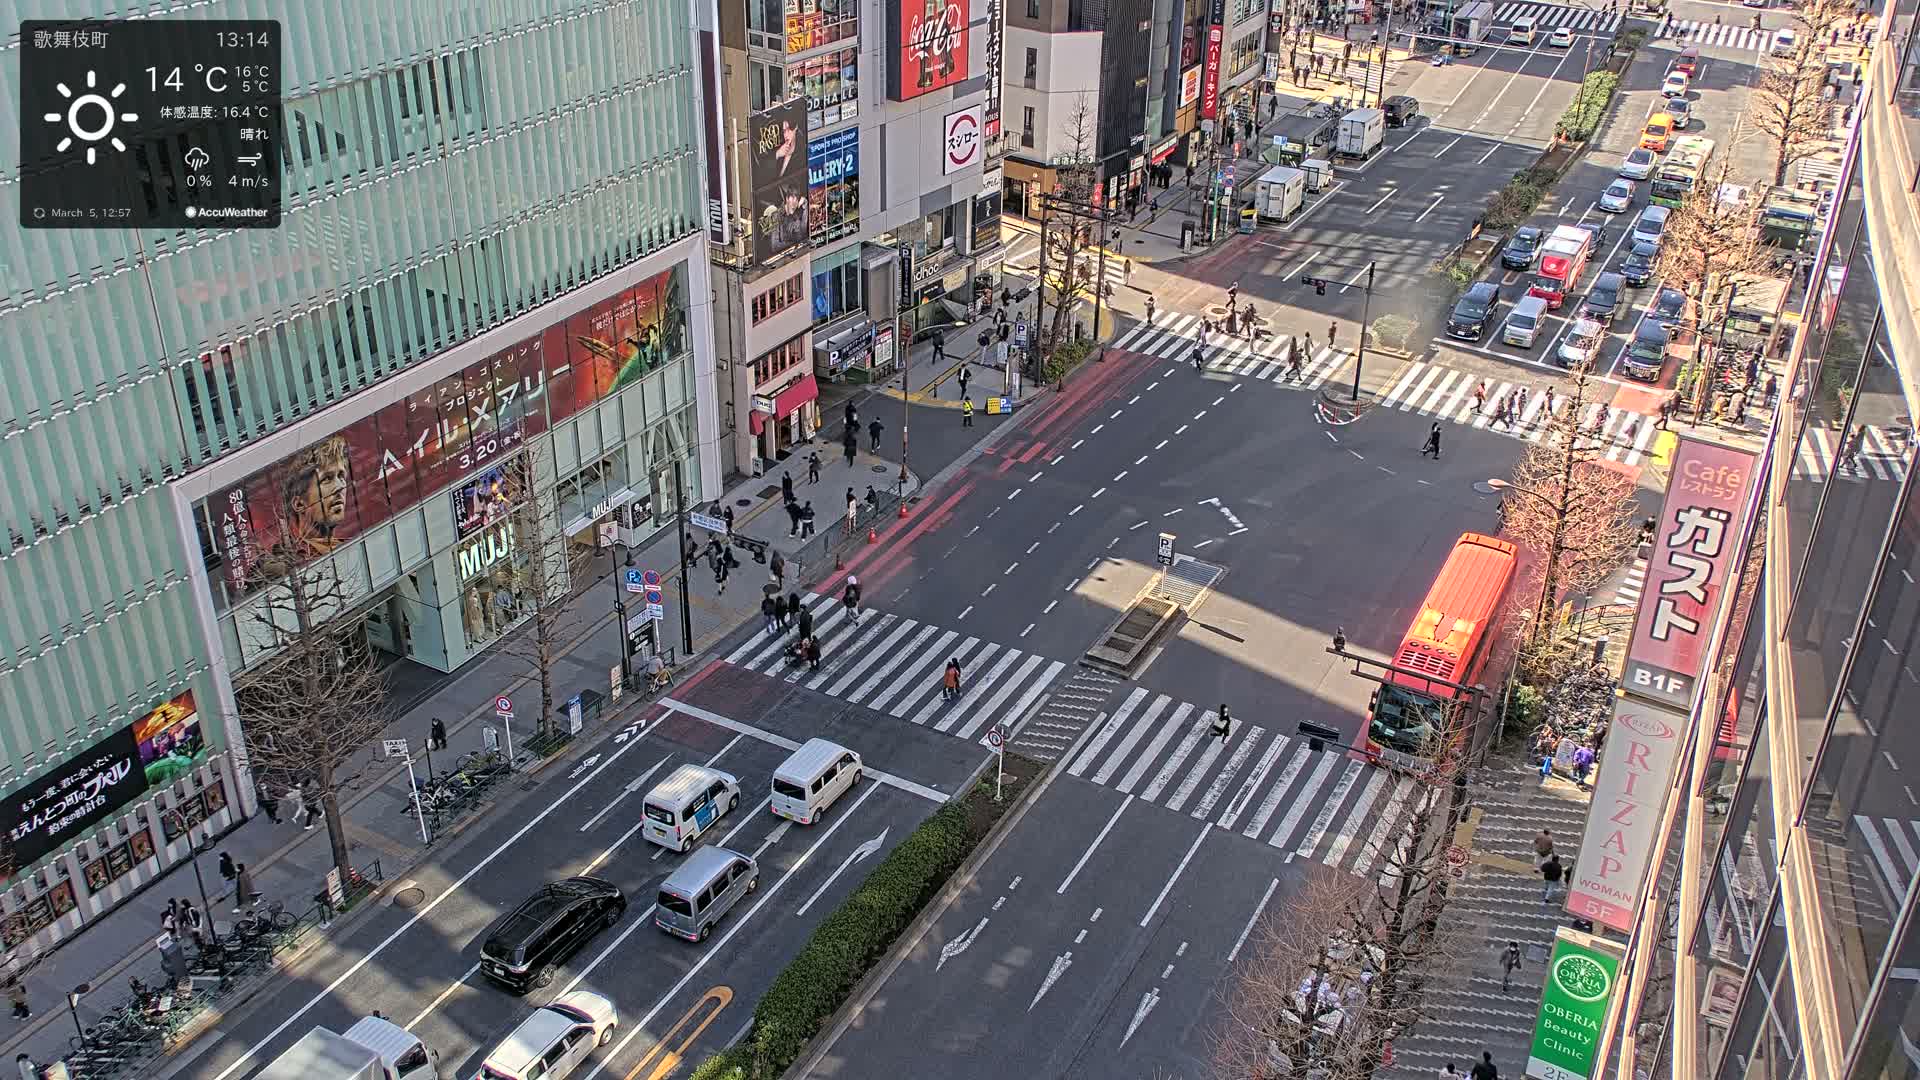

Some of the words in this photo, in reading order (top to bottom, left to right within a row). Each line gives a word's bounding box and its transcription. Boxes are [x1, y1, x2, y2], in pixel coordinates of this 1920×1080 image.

[1206, 44, 1219, 109] バーガーキング
[948, 131, 979, 151] スシロー
[710, 198, 722, 232] MUJI
[409, 341, 541, 412] ライアン・ゴスリング
[446, 376, 503, 412] プロジェクト
[459, 439, 498, 469] 3.20
[1683, 459, 1741, 488] Café
[1680, 479, 1737, 501] レストラン
[593, 496, 614, 519] MUJI
[459, 522, 515, 580] MUJI
[1650, 505, 1732, 642] ガスト
[1634, 669, 1685, 695] B1F
[19, 758, 131, 838] えんとつ町のプペル
[1600, 741, 1652, 880] RIZAP
[1579, 878, 1632, 902] WOMAN
[1585, 900, 1614, 918] 5F
[1560, 969, 1601, 990] OBERIA
[1544, 1003, 1598, 1031] OBERIA
[1544, 1018, 1591, 1045] Beauty
[1543, 1037, 1584, 1060] Clinic
